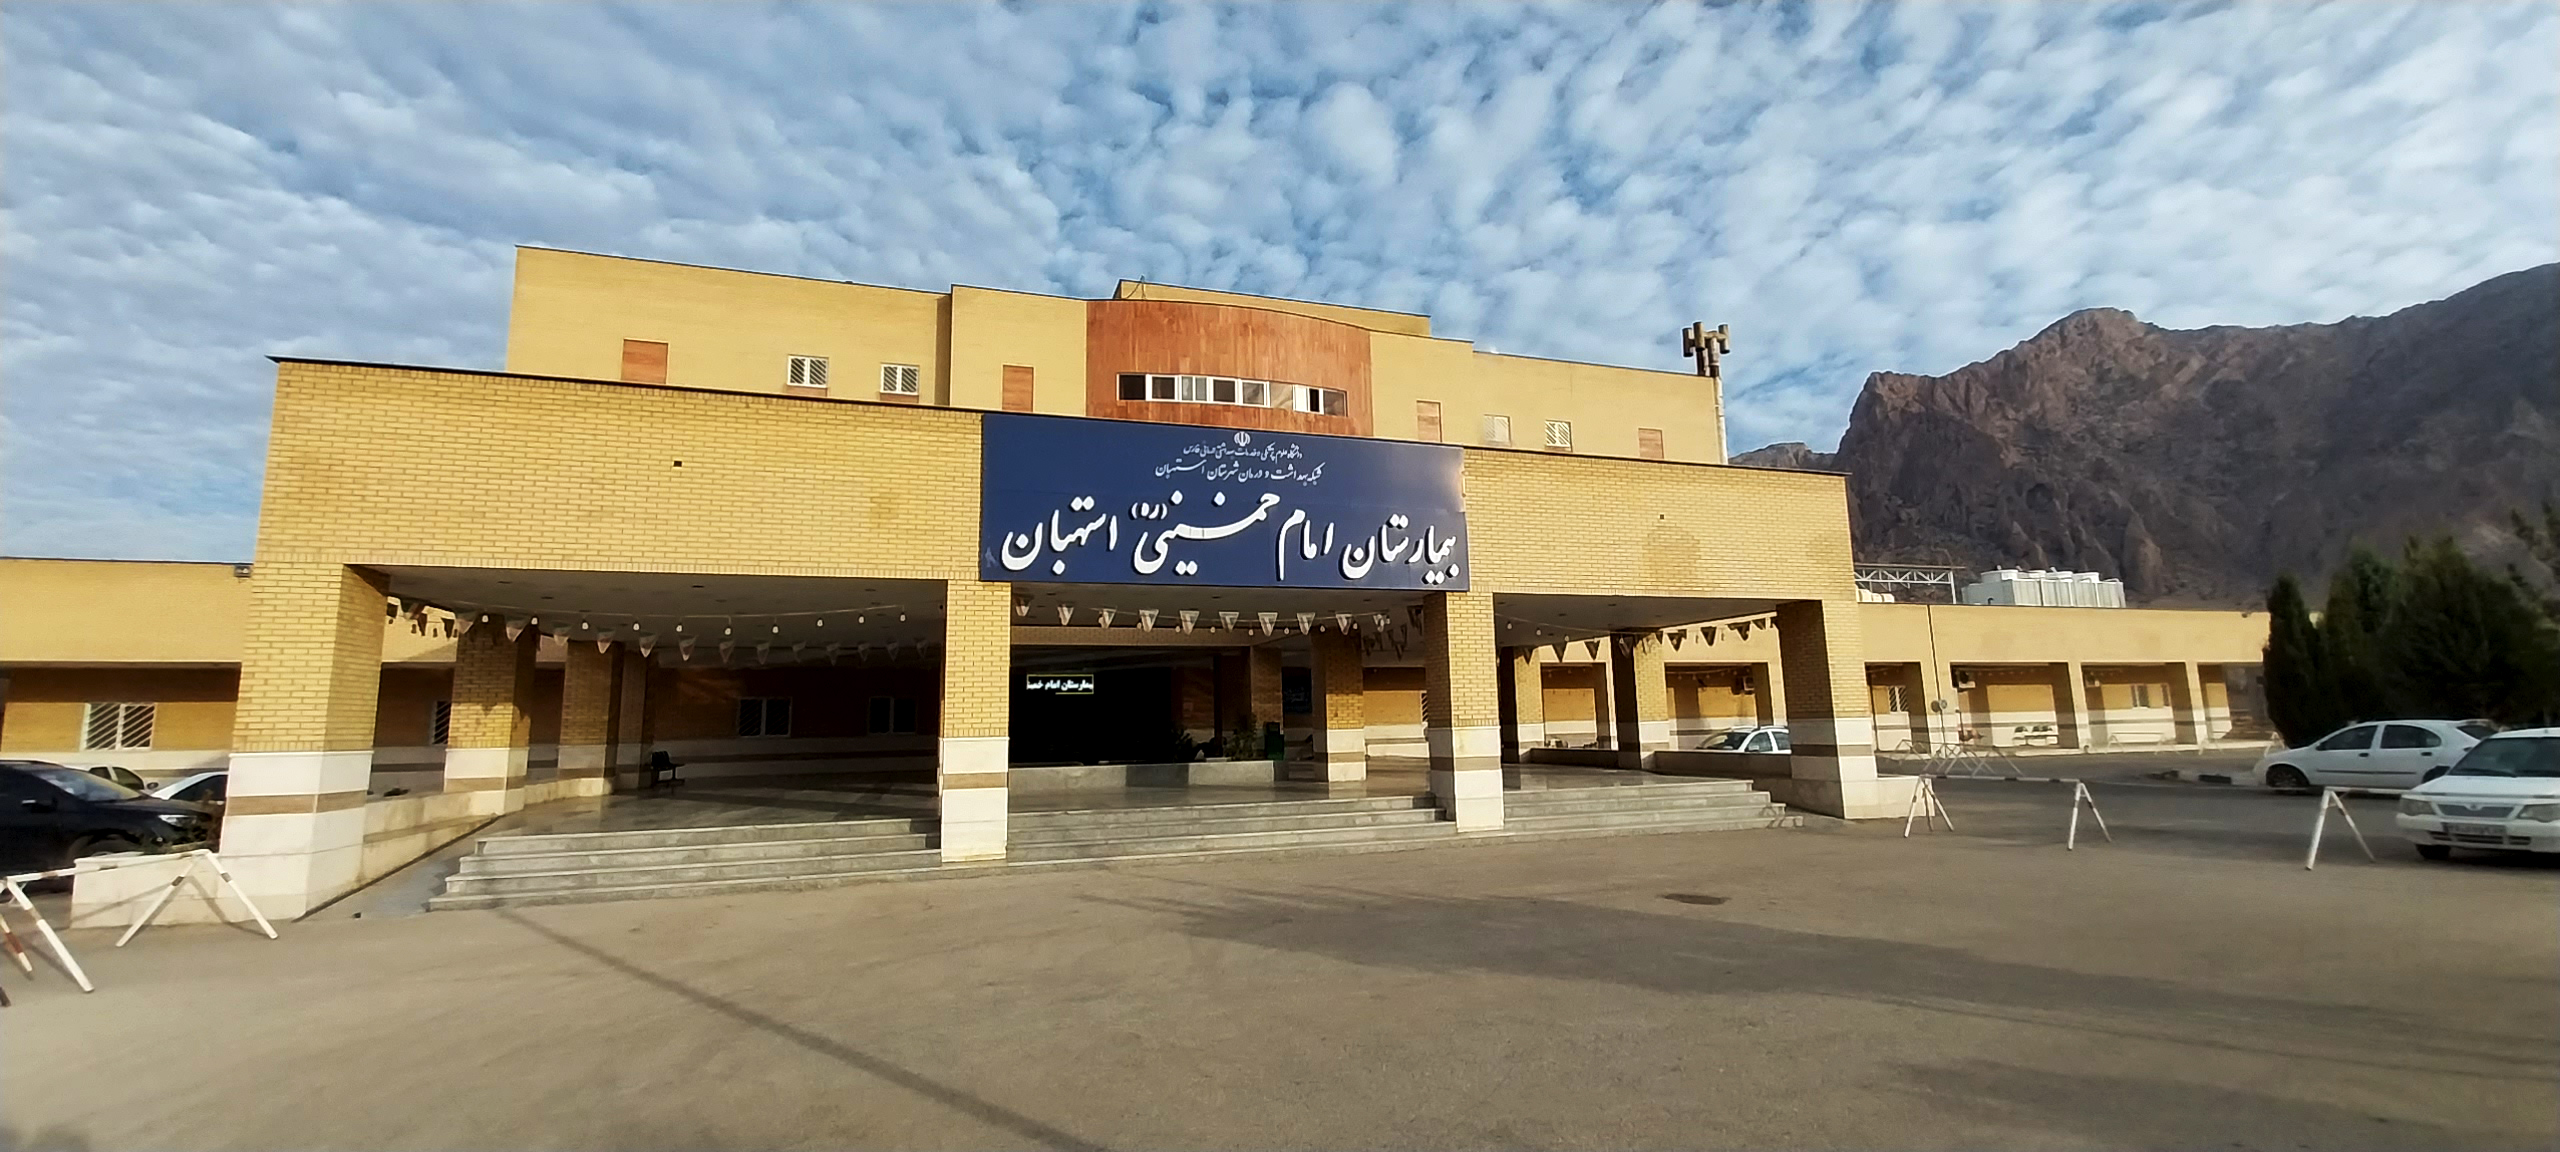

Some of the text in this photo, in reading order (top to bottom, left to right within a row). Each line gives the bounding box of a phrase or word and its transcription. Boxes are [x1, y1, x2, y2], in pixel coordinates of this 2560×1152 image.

[1183, 443, 1200, 455] فارس
[1215, 442, 1236, 460] بهداشتی
[1234, 447, 1257, 457] خدمات
[1260, 441, 1276, 461] پزشکی
[1275, 449, 1288, 465] علوم
[1287, 443, 1303, 460] دانشگاه
[1155, 458, 1326, 487] شبکه بهداشت و درمان شهرستان استهبان
[1001, 495, 1118, 575] استهبان
[1133, 490, 1281, 575] خمینی
[1278, 509, 1334, 581] امام
[1343, 513, 1460, 584] بیمارستان
[1044, 679, 1061, 690] امام
